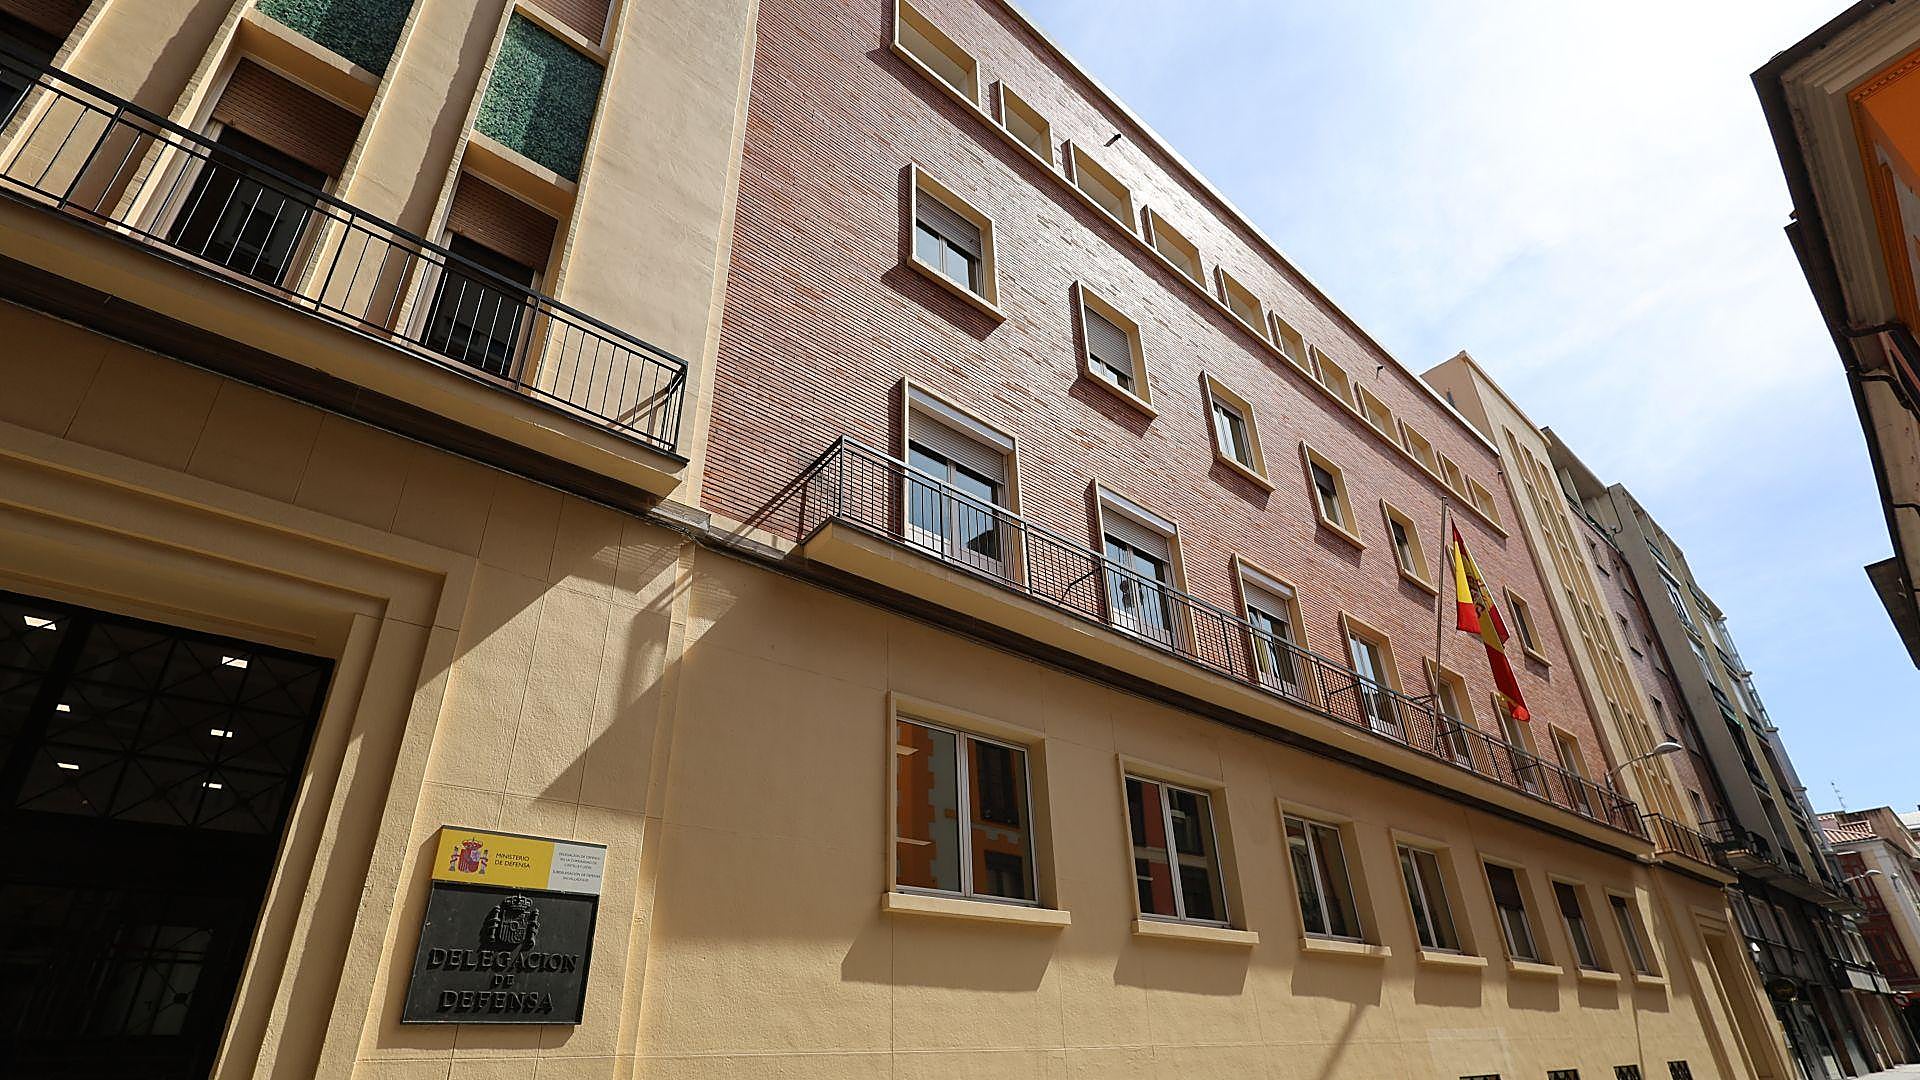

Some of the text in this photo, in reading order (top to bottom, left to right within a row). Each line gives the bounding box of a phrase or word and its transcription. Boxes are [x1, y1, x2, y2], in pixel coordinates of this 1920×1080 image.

[495, 852, 530, 862] MINISTERIO
[504, 860, 530, 868] DEFENSA
[431, 948, 580, 970] DELEGACION
[494, 974, 515, 985] DE
[442, 990, 553, 1010] DEFENSA
